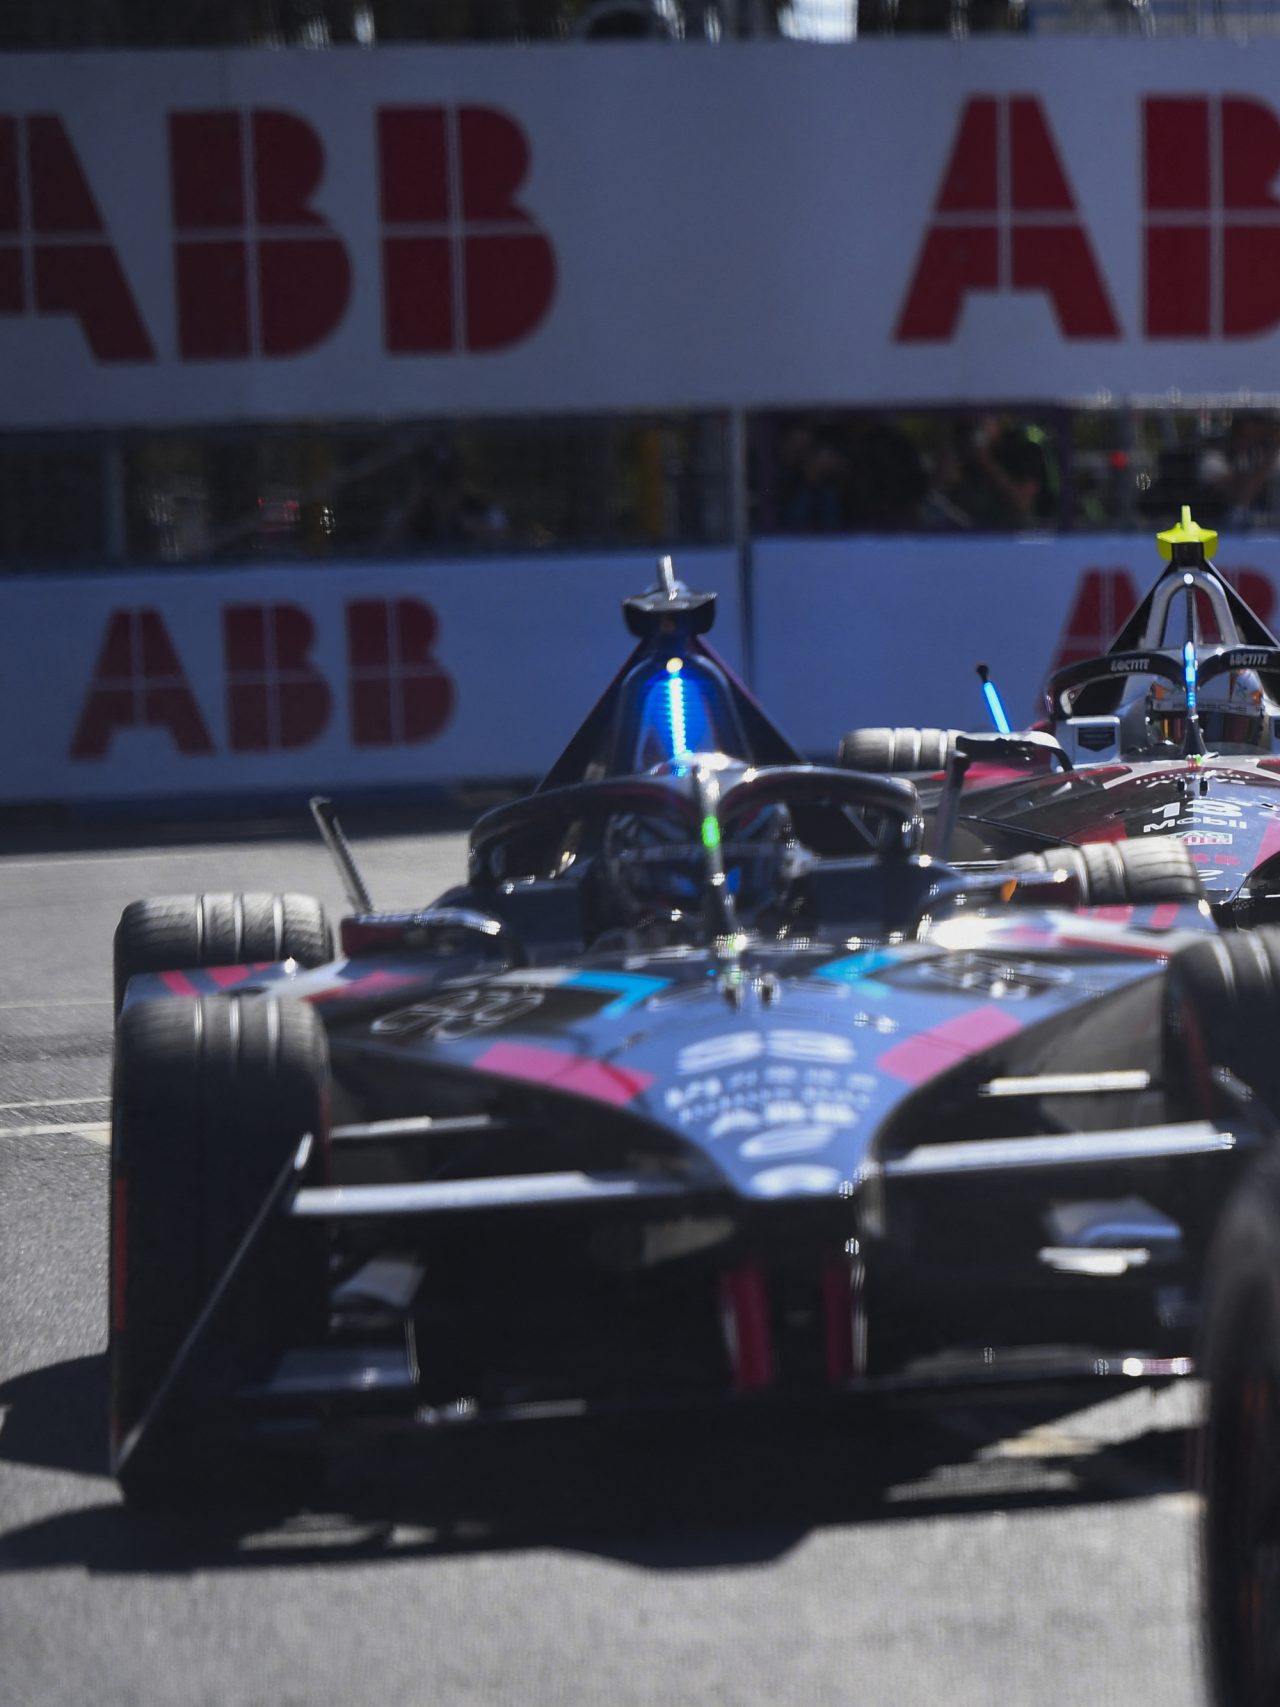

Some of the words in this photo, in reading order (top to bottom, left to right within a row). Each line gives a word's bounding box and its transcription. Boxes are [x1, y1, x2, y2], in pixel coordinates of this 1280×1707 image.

[0, 103, 558, 364] ABB
[1111, 659, 1150, 671] LOCTITE
[1230, 653, 1268, 665] LOCTITE
[68, 596, 457, 762] ABB
[1143, 816, 1248, 832] Mobil
